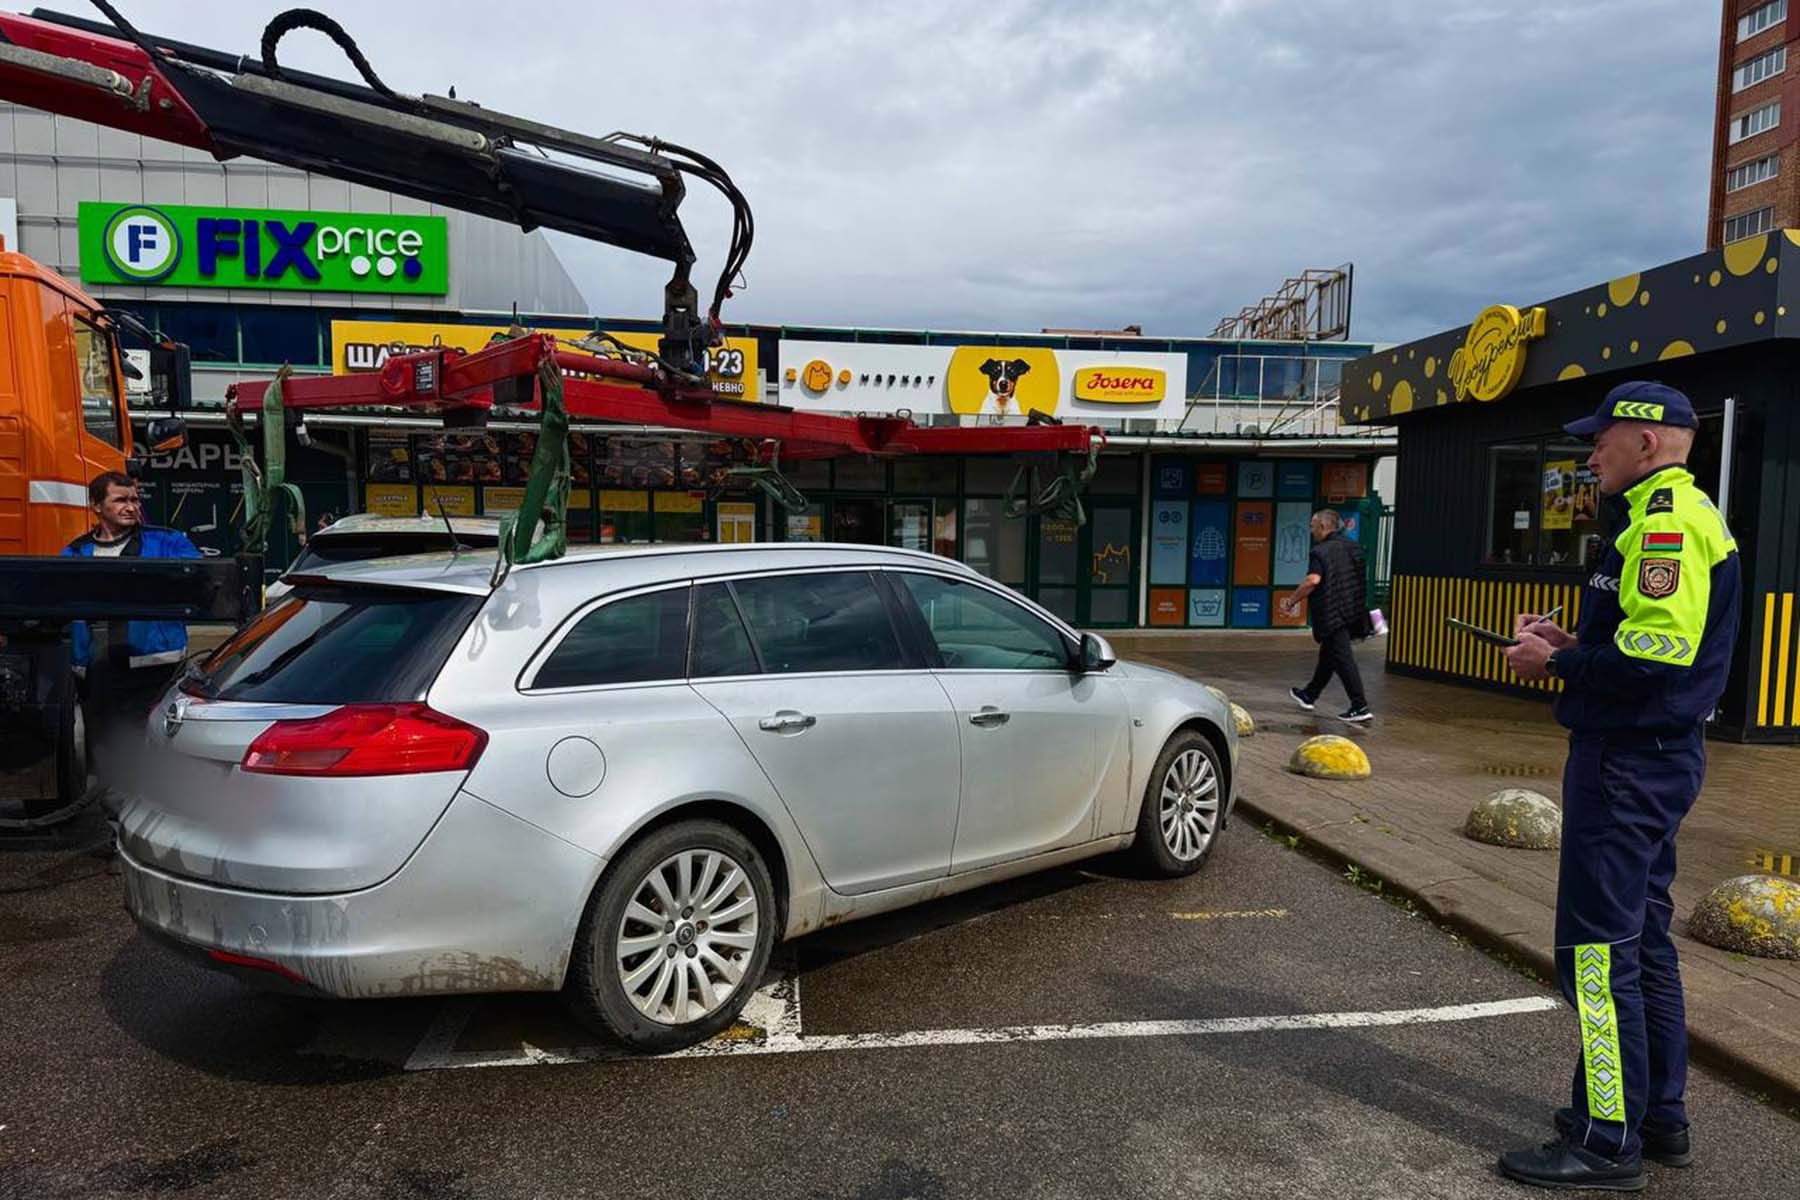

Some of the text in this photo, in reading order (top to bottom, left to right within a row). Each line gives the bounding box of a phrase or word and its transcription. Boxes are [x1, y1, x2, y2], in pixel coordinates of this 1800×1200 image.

[127, 216, 424, 280] F FIX price
[1086, 371, 1155, 390] Josera
